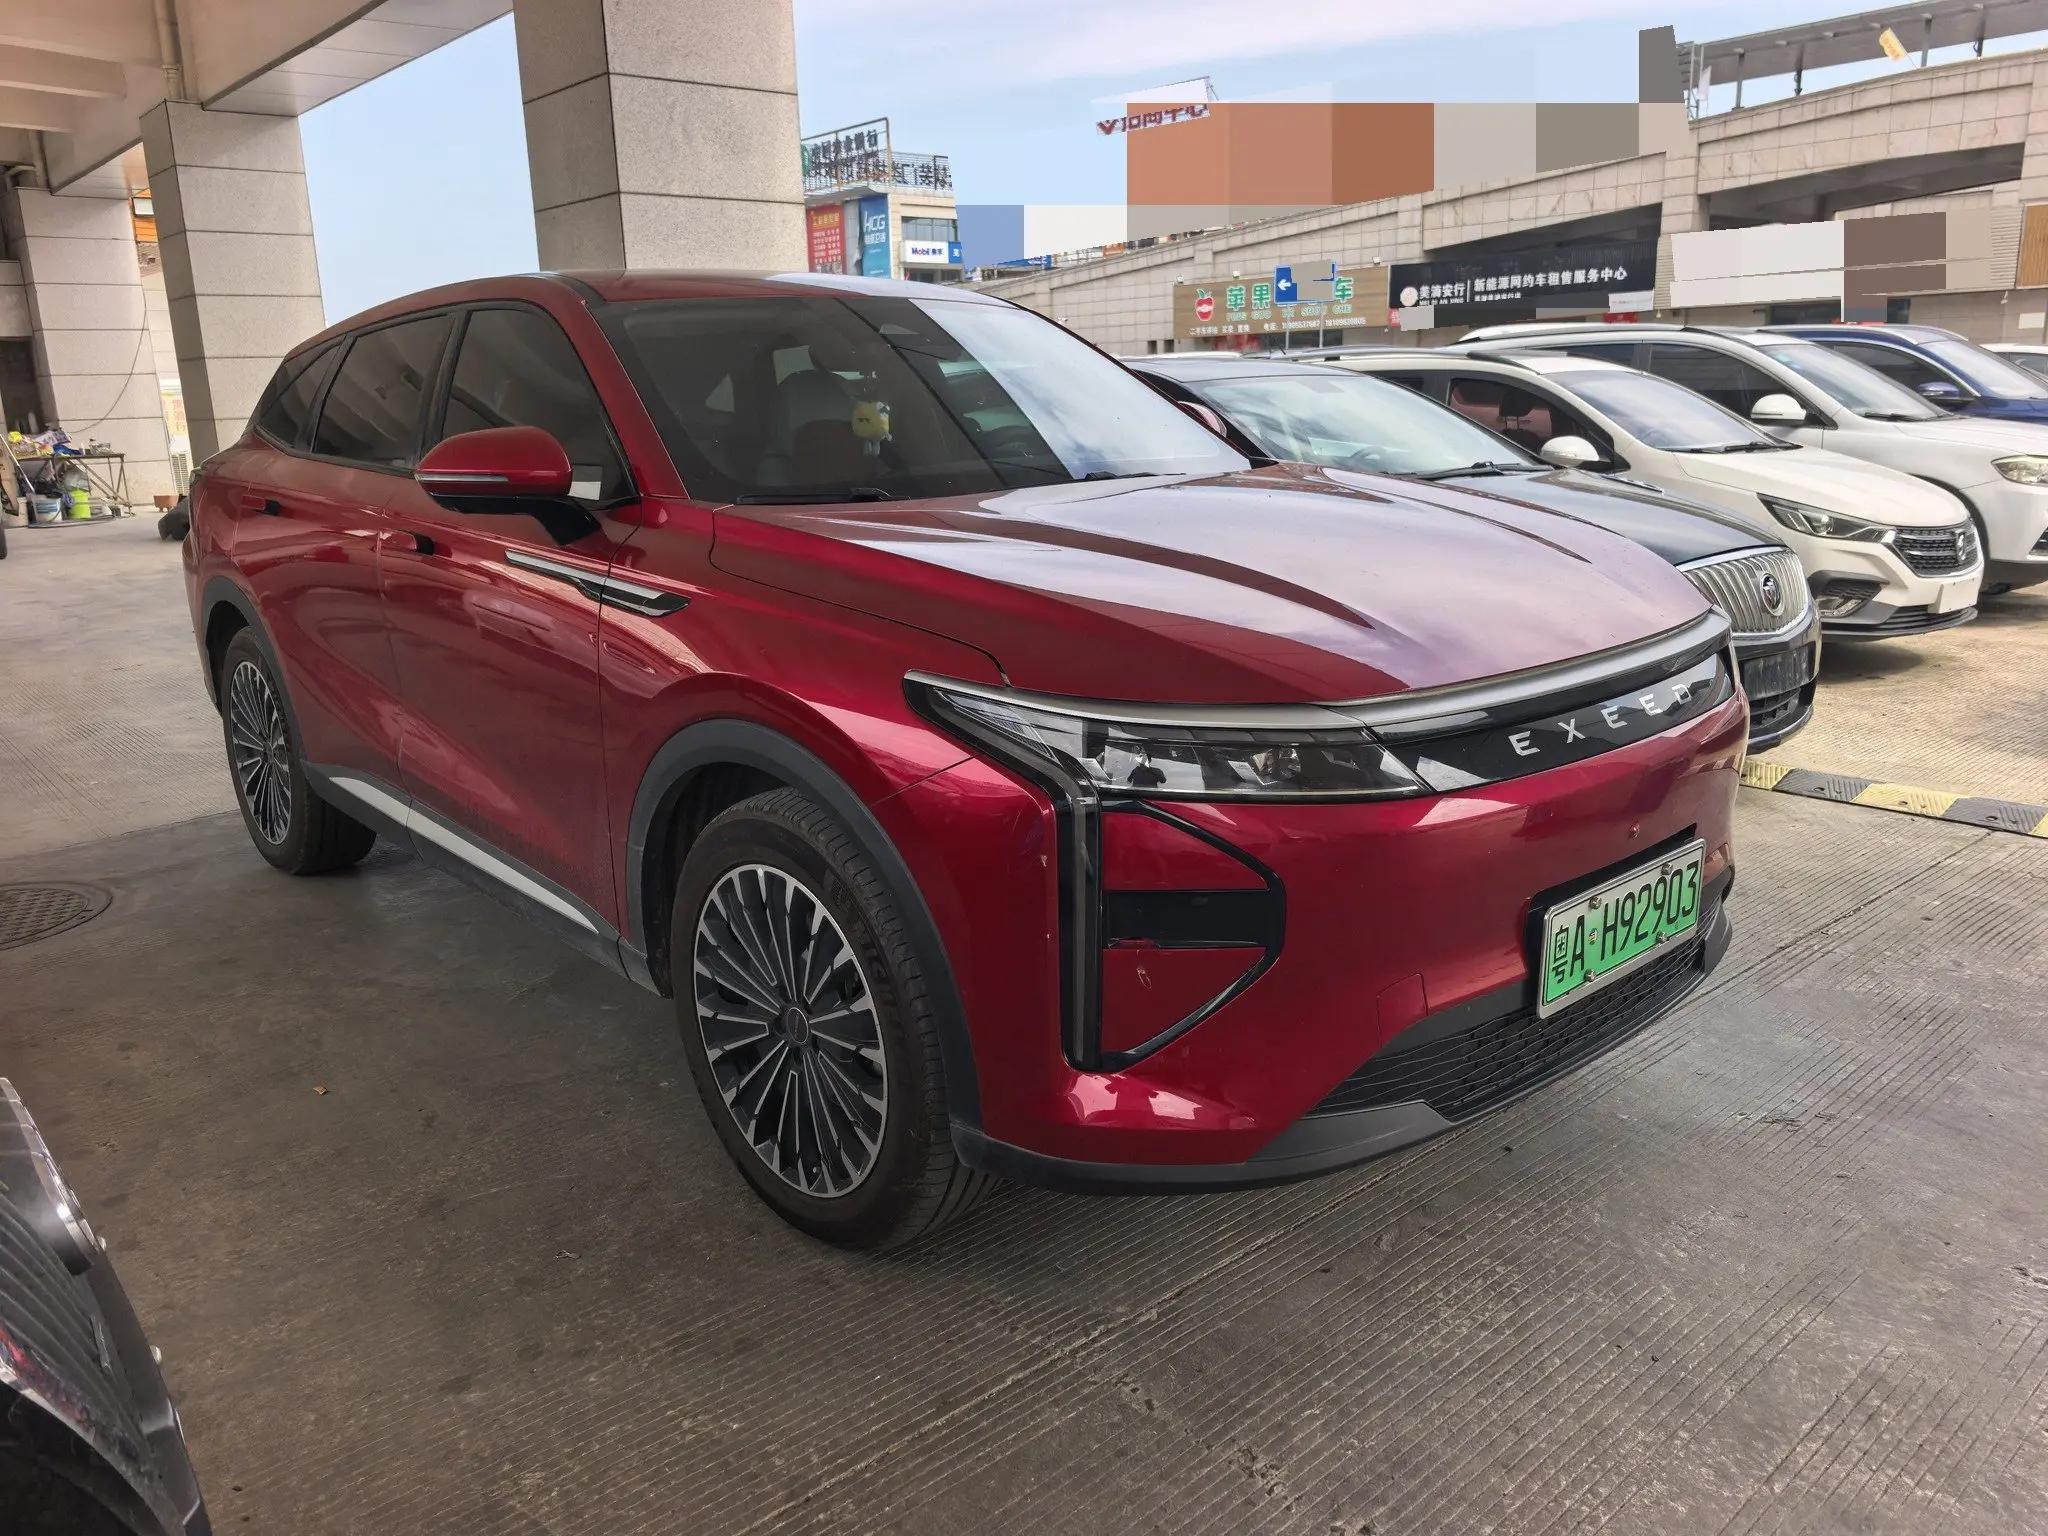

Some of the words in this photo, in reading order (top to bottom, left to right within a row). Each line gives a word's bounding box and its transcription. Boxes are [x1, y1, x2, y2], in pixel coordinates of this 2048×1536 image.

[912, 247, 929, 256] Mobil
[1474, 266, 1628, 293] 新能源网约车租售服务中心
[1508, 683, 1692, 757] EXEED
